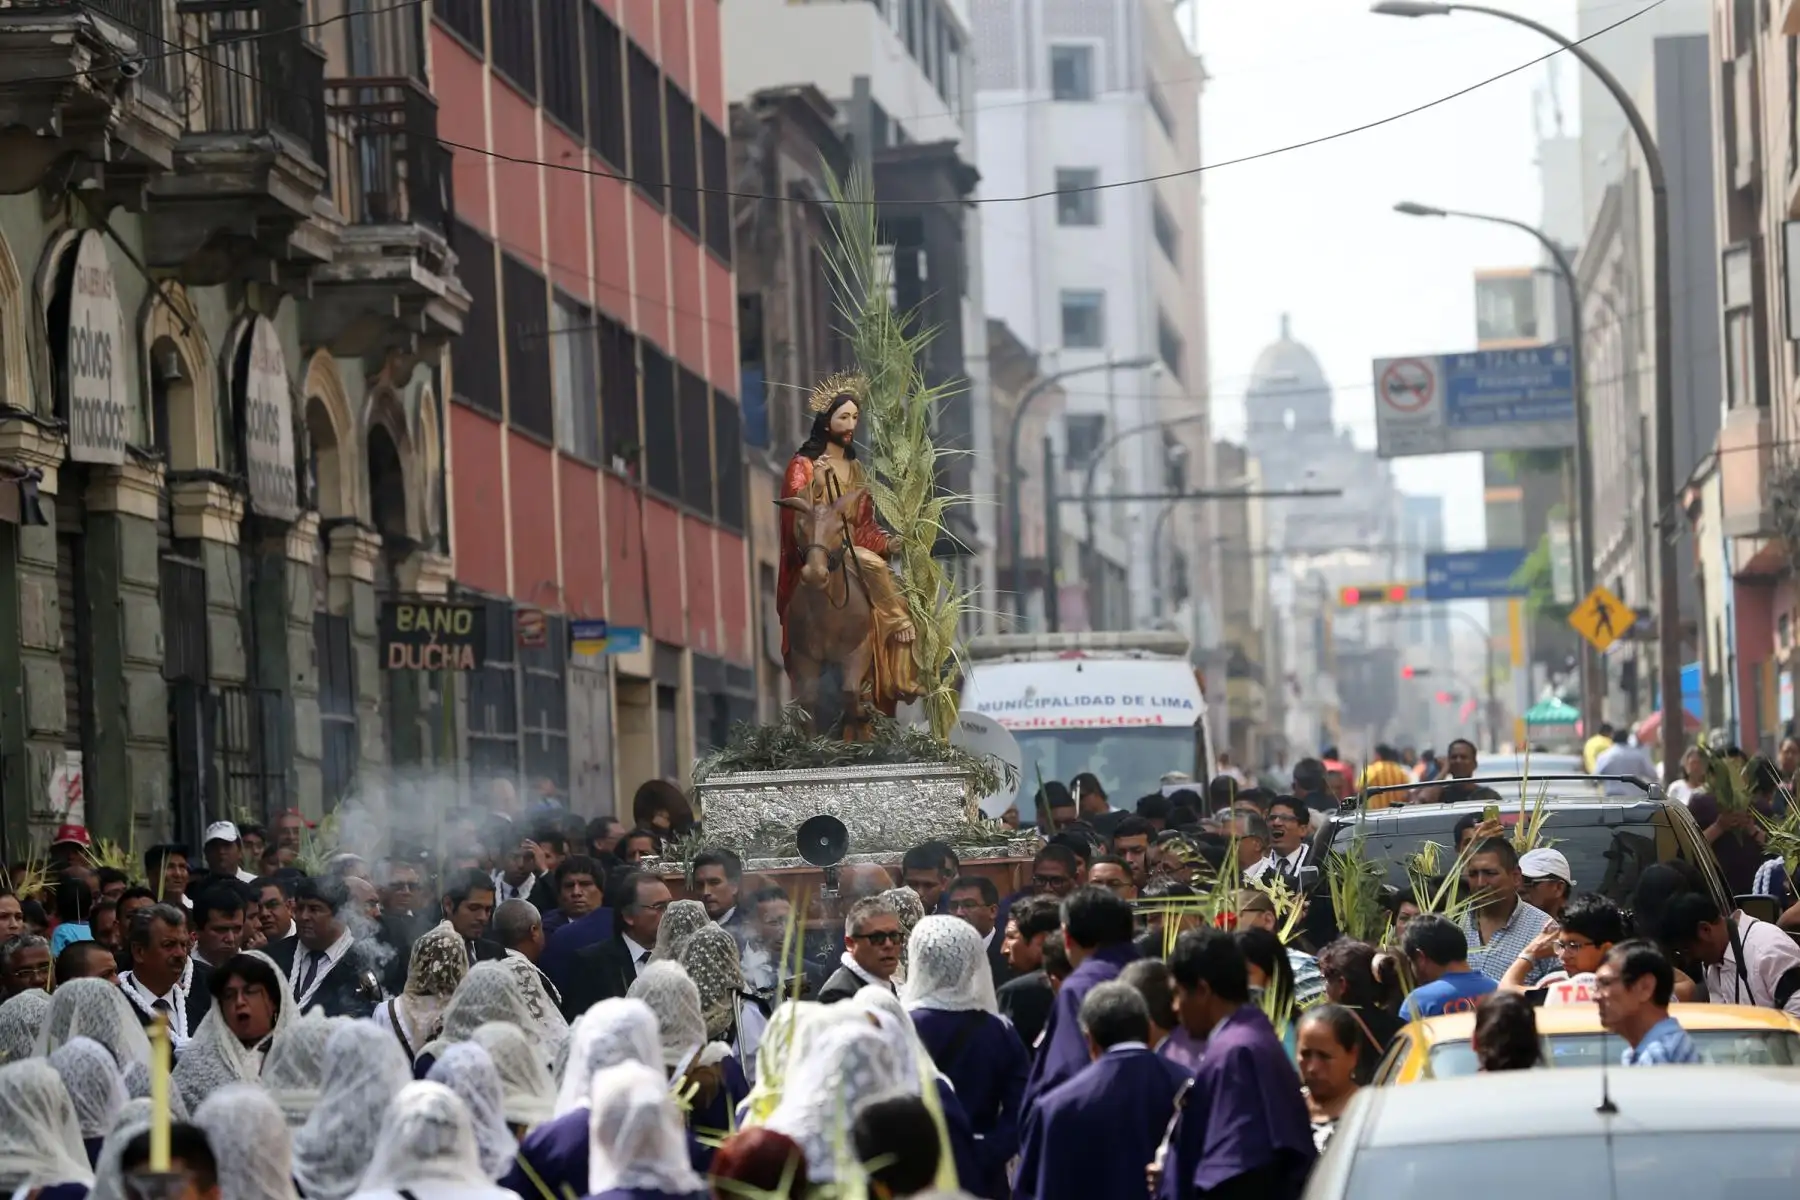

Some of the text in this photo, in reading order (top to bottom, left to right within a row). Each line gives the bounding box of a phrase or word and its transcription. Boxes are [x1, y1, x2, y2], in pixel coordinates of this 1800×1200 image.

[388, 641, 476, 670] DUCHA
[977, 695, 1194, 713] MUNICIPALIDAD DE LIMA
[1557, 985, 1591, 1003] TA
